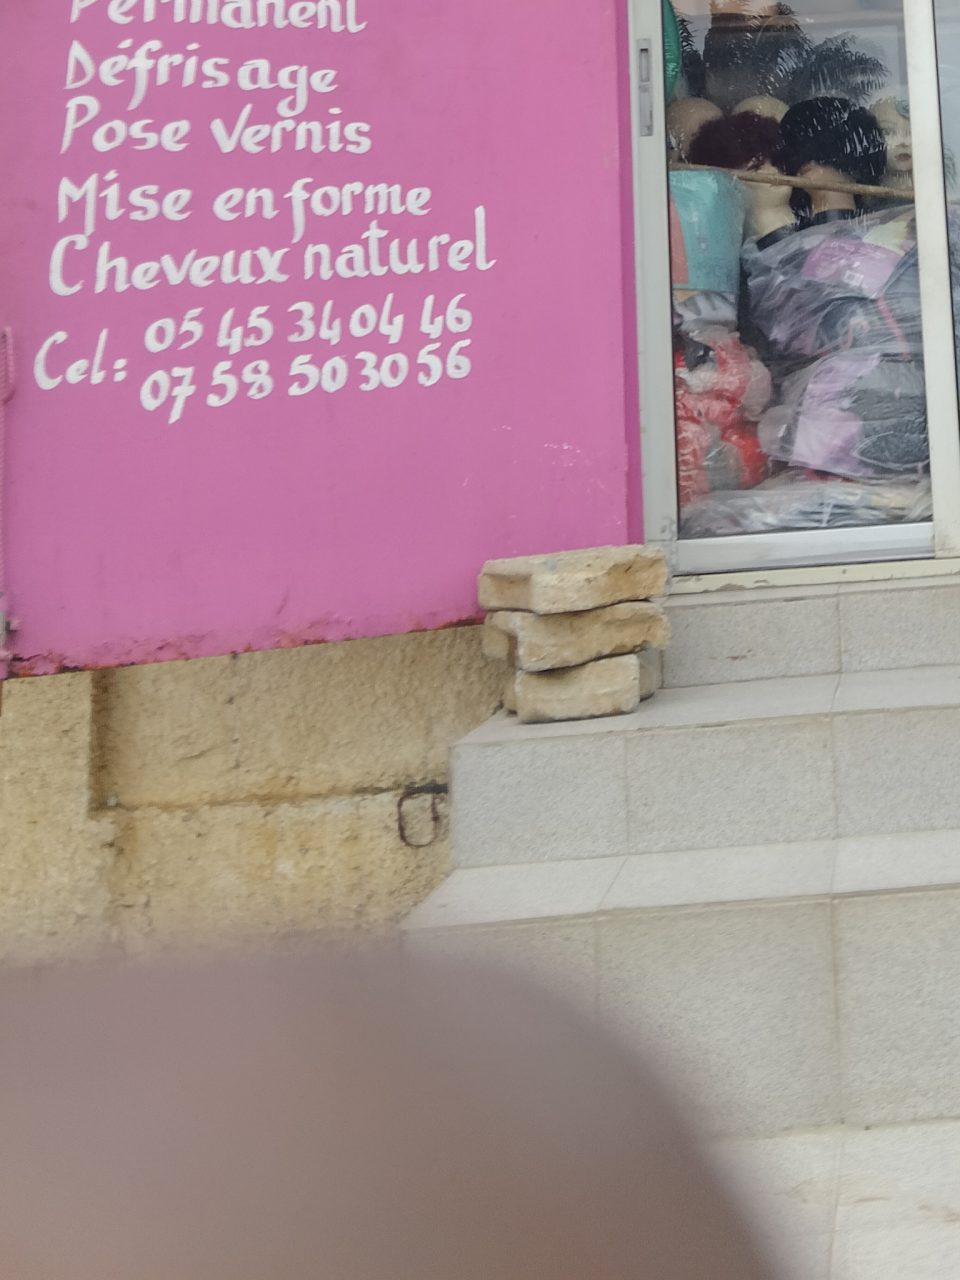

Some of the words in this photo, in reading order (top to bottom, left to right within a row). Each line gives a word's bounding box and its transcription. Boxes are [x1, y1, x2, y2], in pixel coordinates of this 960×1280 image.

[64, 39, 339, 117] Défrisage
[60, 96, 192, 154] Pose
[57, 170, 193, 236] Mise
[212, 186, 280, 221] en
[283, 177, 431, 243] forme
[48, 234, 291, 297] Cheveux
[303, 205, 498, 281] naturel
[33, 328, 128, 391] Cel:
[144, 306, 204, 354] 05
[216, 305, 274, 355] 45
[287, 299, 342, 346] 34
[348, 292, 404, 344] 04
[419, 292, 473, 340] 46
[139, 366, 197, 425] 07
[206, 359, 274, 408] 58
[287, 354, 348, 398] 50
[358, 350, 409, 390] 30
[416, 338, 472, 387] 56
